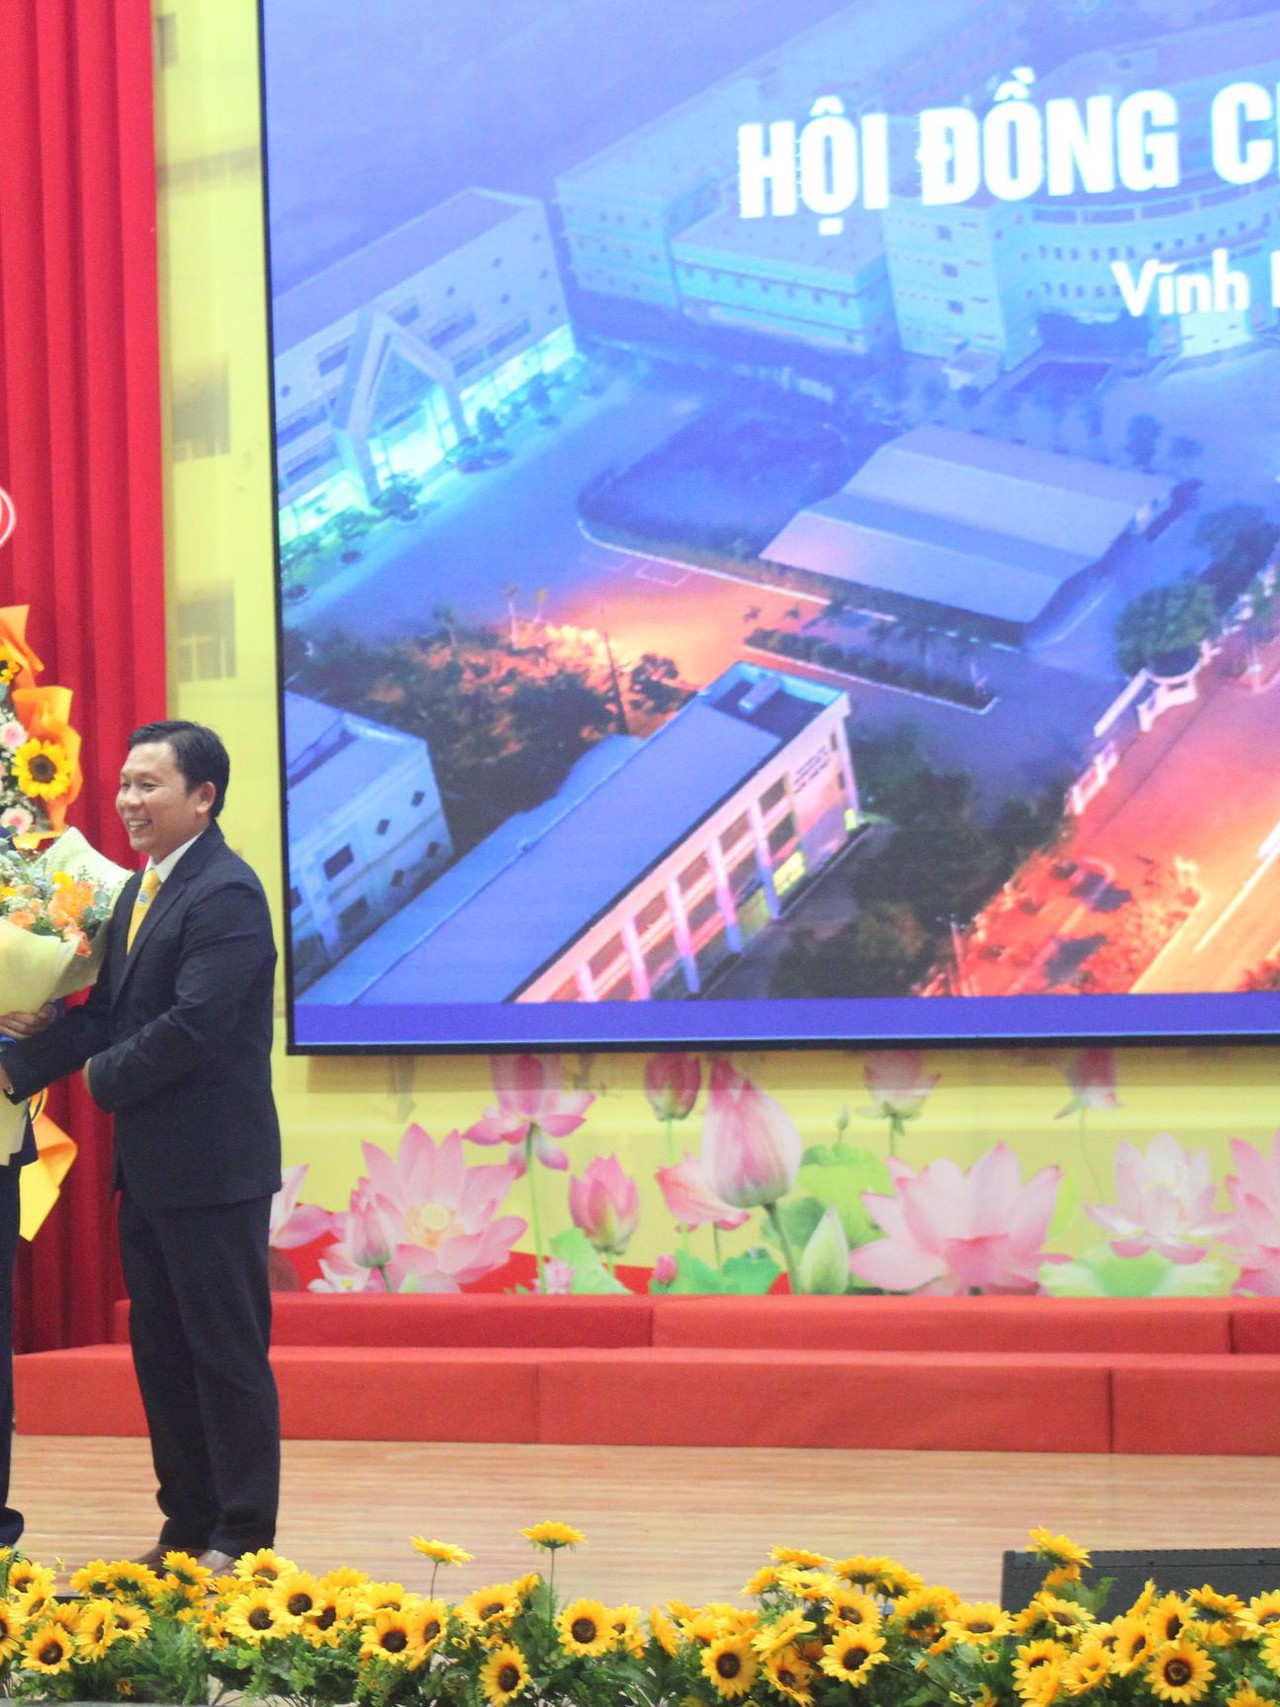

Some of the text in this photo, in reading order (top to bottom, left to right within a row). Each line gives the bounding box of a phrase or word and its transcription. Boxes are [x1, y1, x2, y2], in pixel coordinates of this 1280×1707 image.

[737, 95, 889, 236] HỘI
[915, 67, 1179, 206] ĐỒNG
[1111, 247, 1250, 317] Vĩnh
